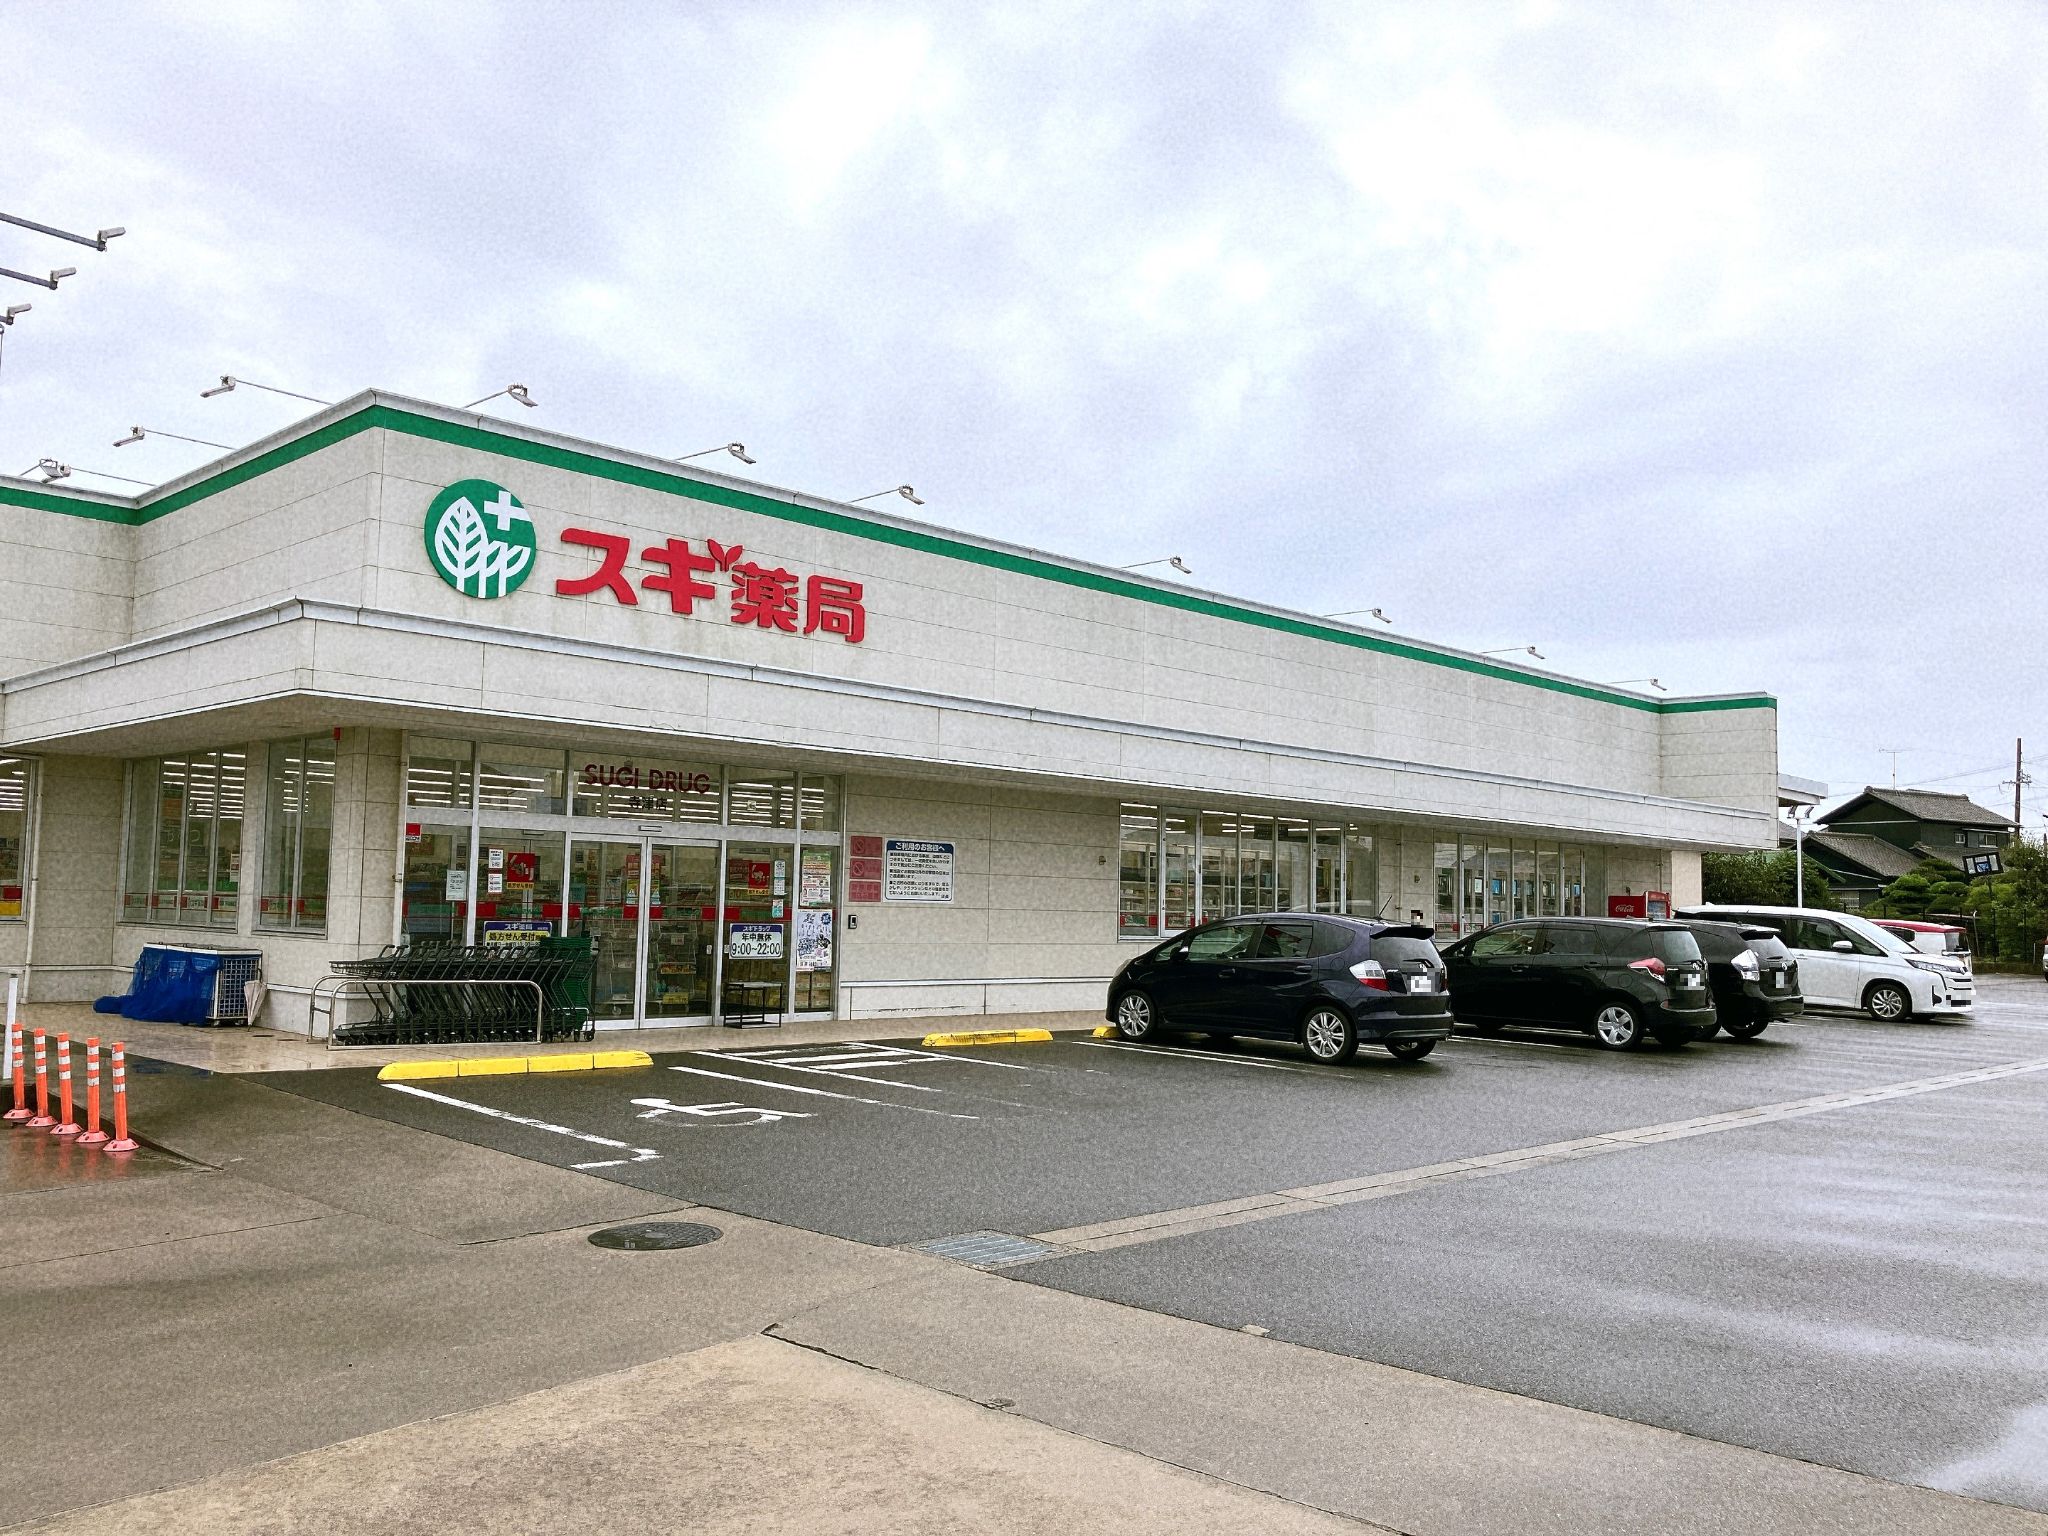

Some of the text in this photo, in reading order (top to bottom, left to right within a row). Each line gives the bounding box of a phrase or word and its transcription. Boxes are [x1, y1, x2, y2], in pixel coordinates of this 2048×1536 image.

[556, 527, 866, 643] スギ薬局
[584, 763, 711, 794] SUGI DRUG
[741, 933, 773, 942] 年中無休
